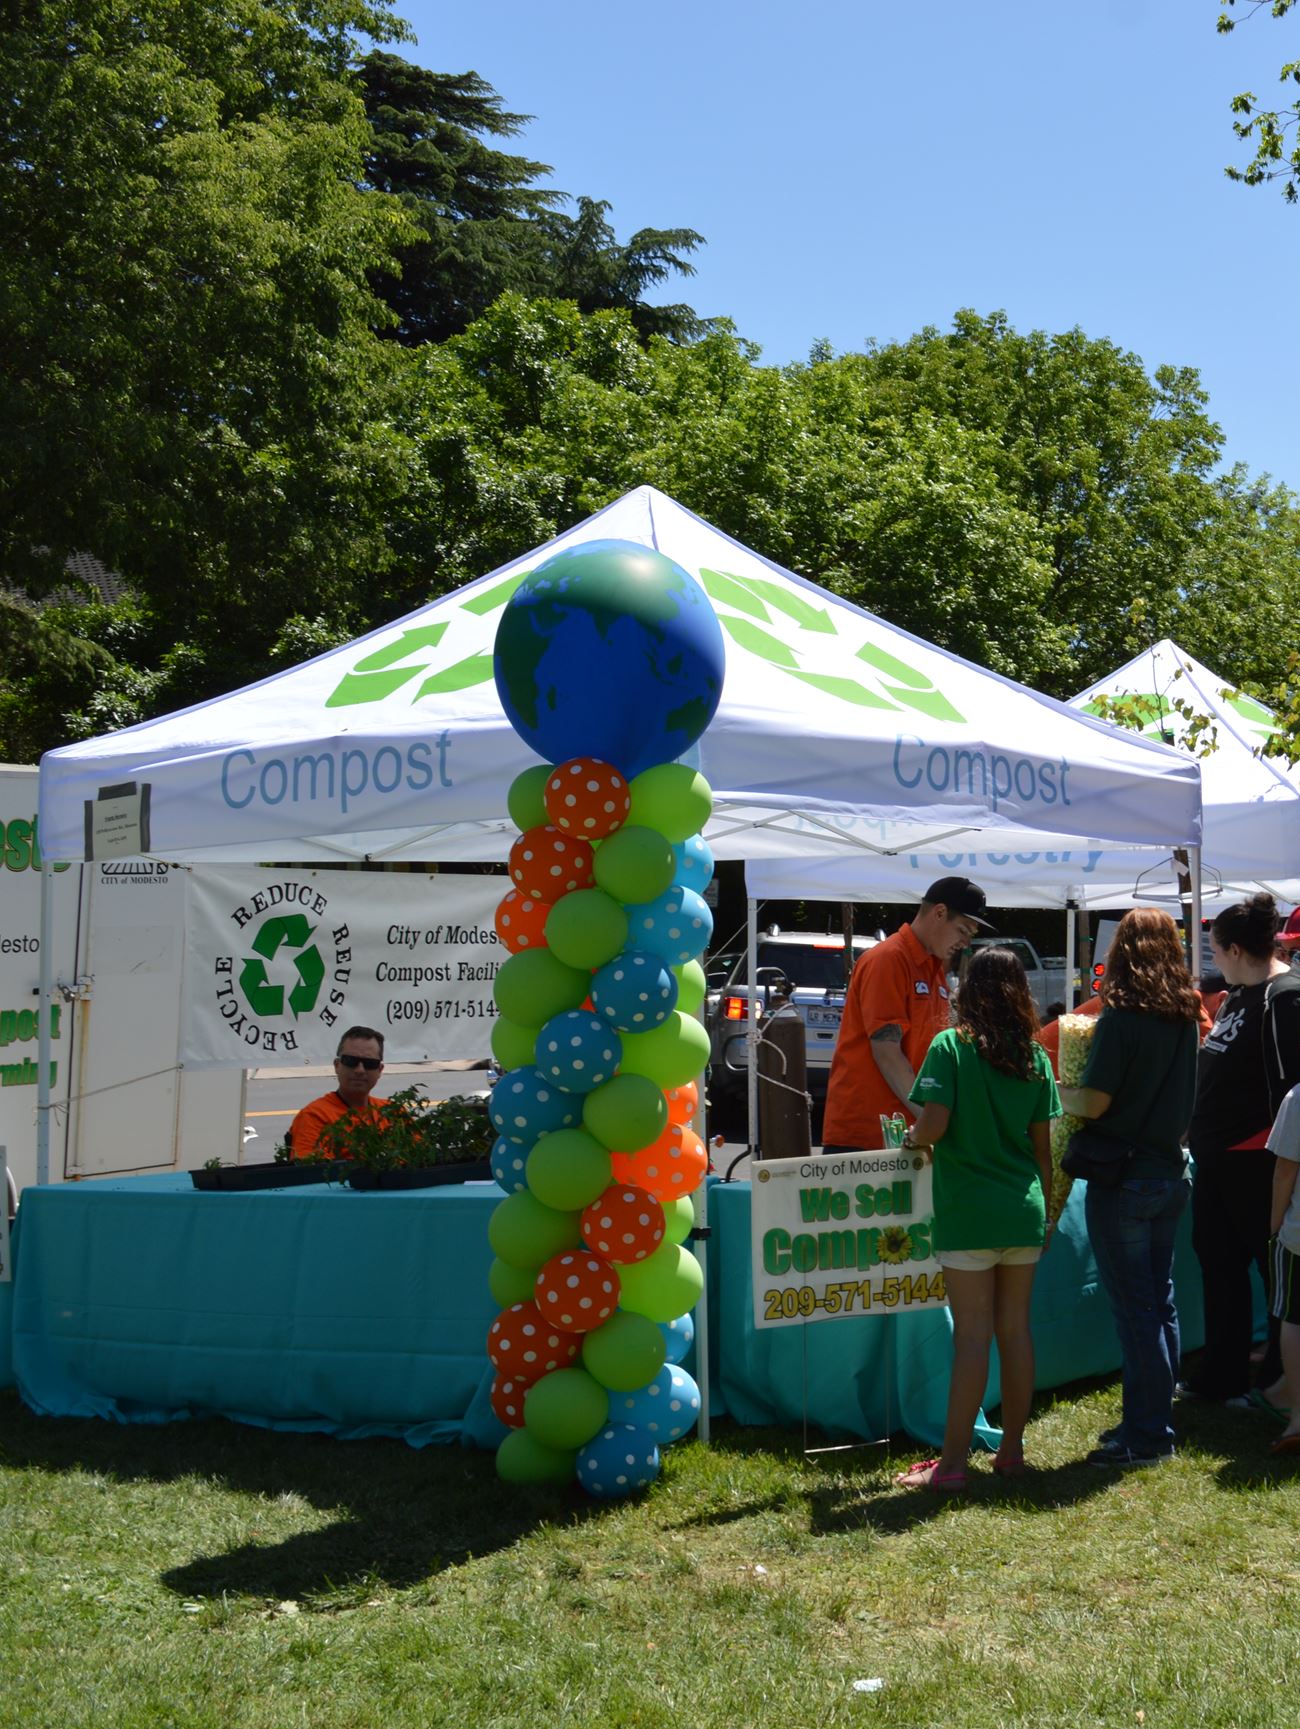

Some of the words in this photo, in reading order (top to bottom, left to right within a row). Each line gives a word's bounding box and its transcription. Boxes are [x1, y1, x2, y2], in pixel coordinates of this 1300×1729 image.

[221, 728, 453, 814] Compost
[893, 733, 1071, 812] Compost
[101, 876, 119, 885] CITY
[131, 876, 169, 885] MODESTO
[231, 882, 328, 930] REDUCE
[0, 934, 40, 953] esto
[387, 924, 421, 950] City
[425, 925, 443, 945] of
[444, 925, 501, 945] Modes
[319, 923, 352, 1028] REUSE
[375, 961, 452, 987] Compost
[457, 962, 504, 981] Facili
[215, 956, 299, 1051] RECYCLE
[386, 999, 430, 1024] (209)
[800, 1163, 828, 1180] City
[832, 1161, 846, 1176] of
[850, 1156, 909, 1174] Modesto
[799, 1187, 850, 1223] We
[854, 1180, 913, 1219] Sell
[762, 1217, 938, 1276] Comps
[763, 1272, 946, 1321] 209-571-5144
